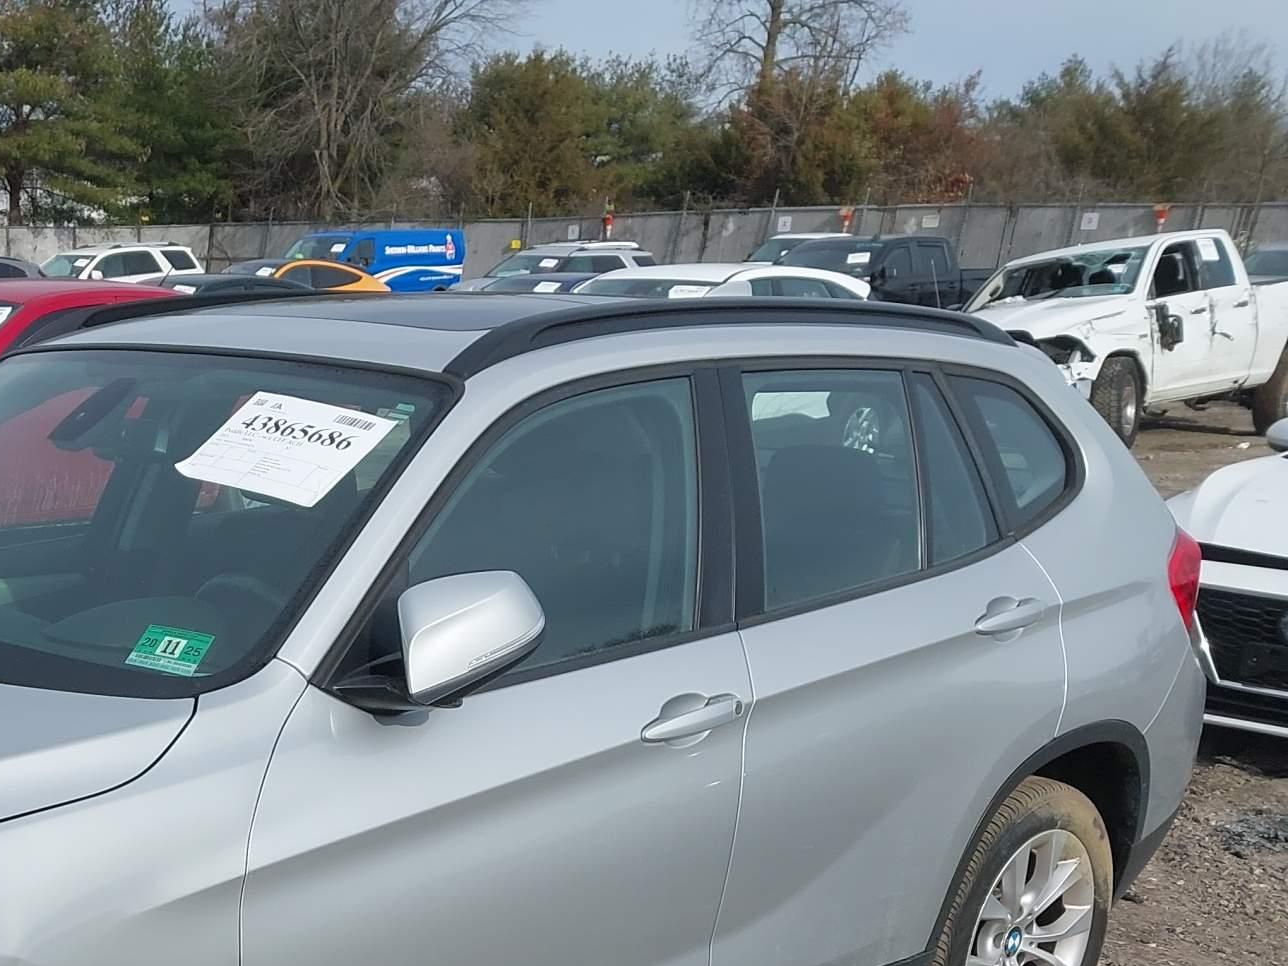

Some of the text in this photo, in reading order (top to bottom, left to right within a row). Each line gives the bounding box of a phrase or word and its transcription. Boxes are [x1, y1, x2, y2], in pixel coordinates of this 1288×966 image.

[241, 413, 359, 451] 43865686
[142, 637, 203, 657] 20 11 25
